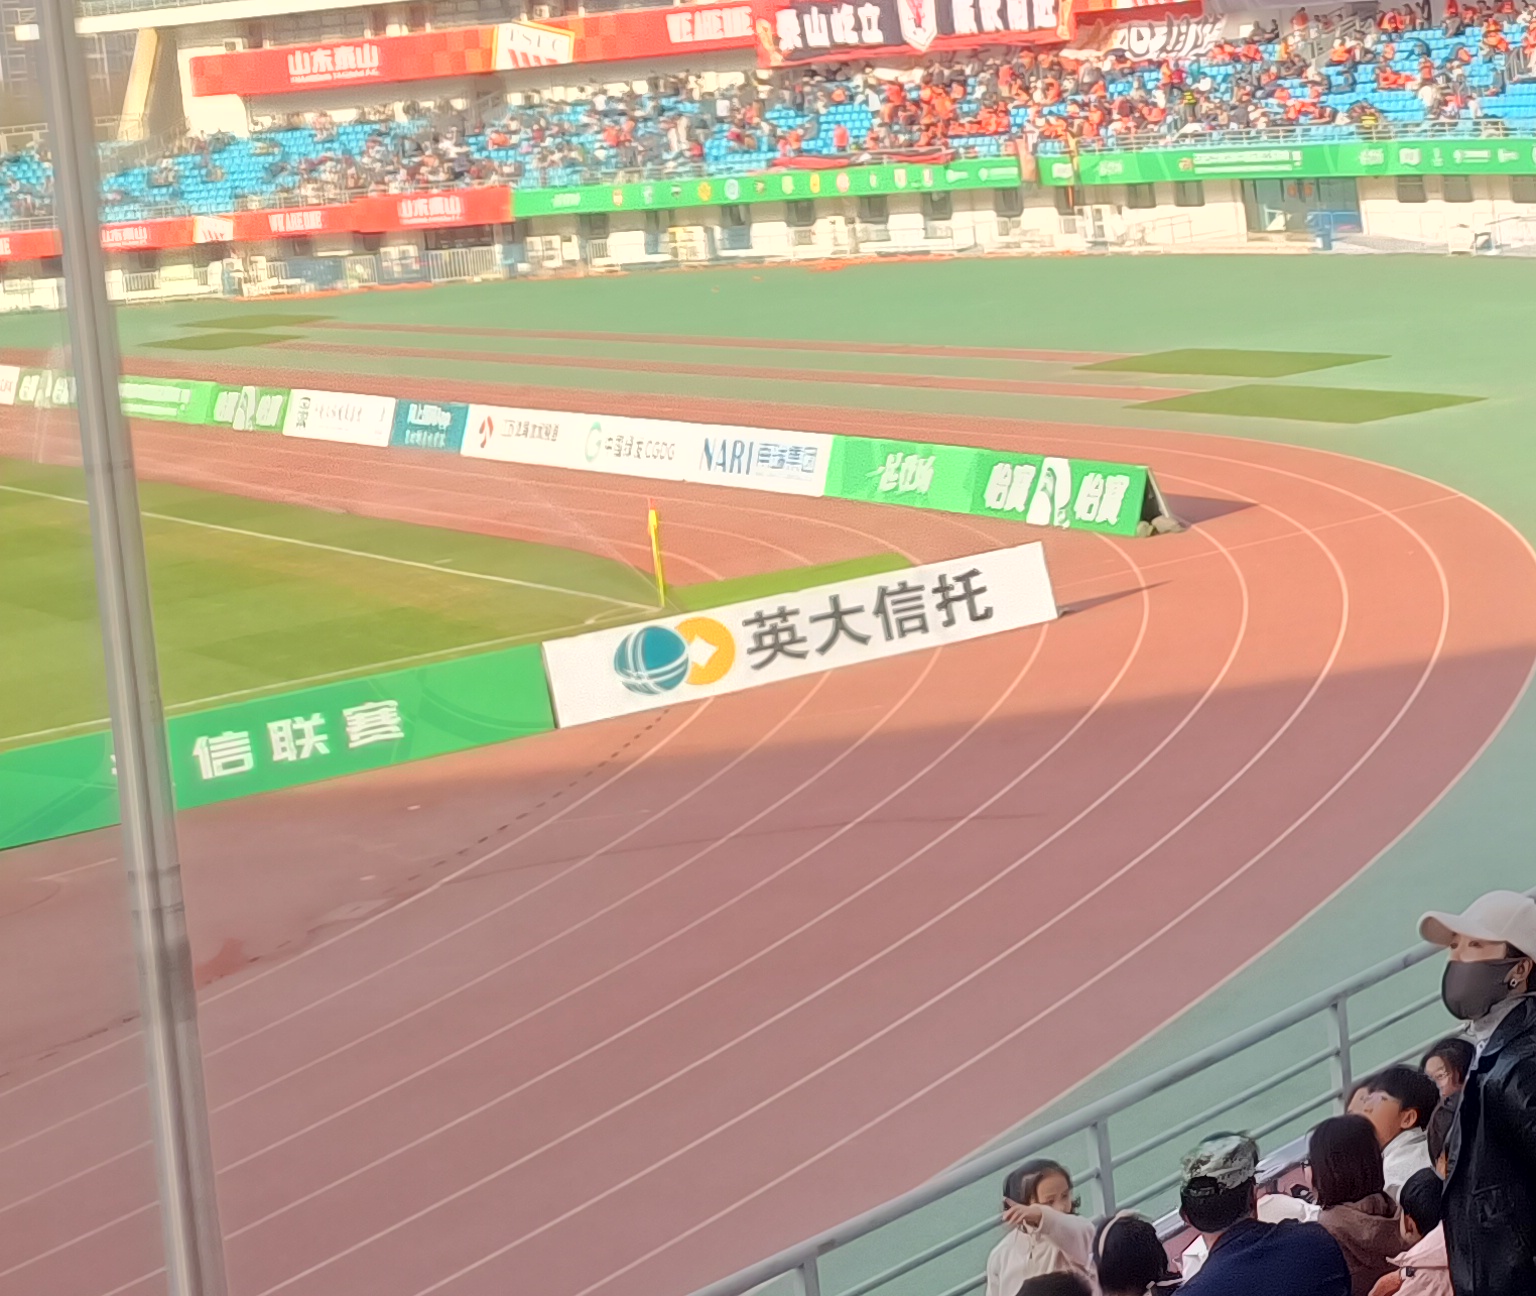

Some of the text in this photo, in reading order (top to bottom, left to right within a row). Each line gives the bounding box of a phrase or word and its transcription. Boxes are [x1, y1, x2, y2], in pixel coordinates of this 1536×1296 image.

[700, 437, 754, 475] NARI
[742, 568, 994, 670] 英大信托
[110, 700, 404, 780] 信联赛
